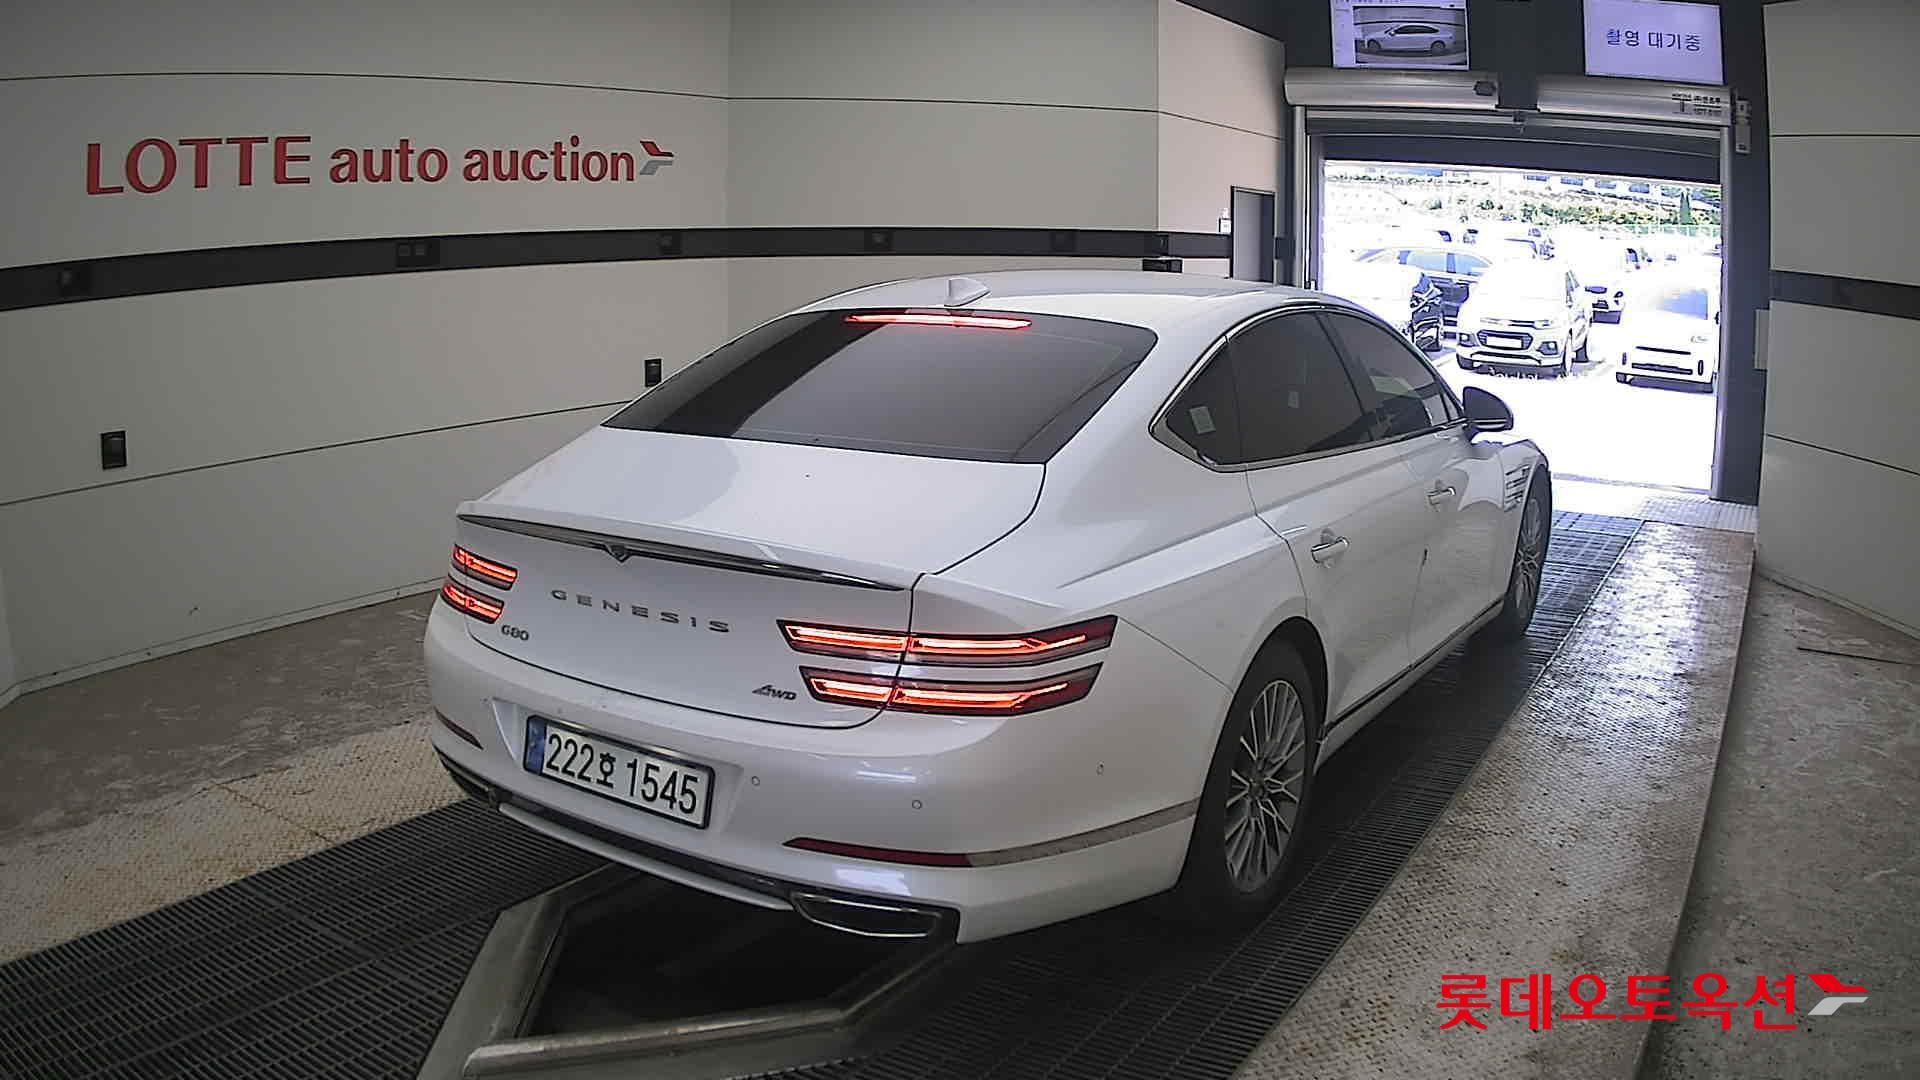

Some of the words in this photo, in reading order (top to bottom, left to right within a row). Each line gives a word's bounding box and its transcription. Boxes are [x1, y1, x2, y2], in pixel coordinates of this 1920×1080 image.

[1607, 28, 1640, 48] 촬영
[86, 135, 312, 196] LOTTE
[329, 138, 448, 184] auto
[463, 135, 635, 183] auction
[551, 588, 730, 633] GENESIS
[500, 623, 530, 642] G80
[751, 683, 798, 701] AWD
[545, 733, 616, 789] 222호
[626, 757, 699, 814] 1545
